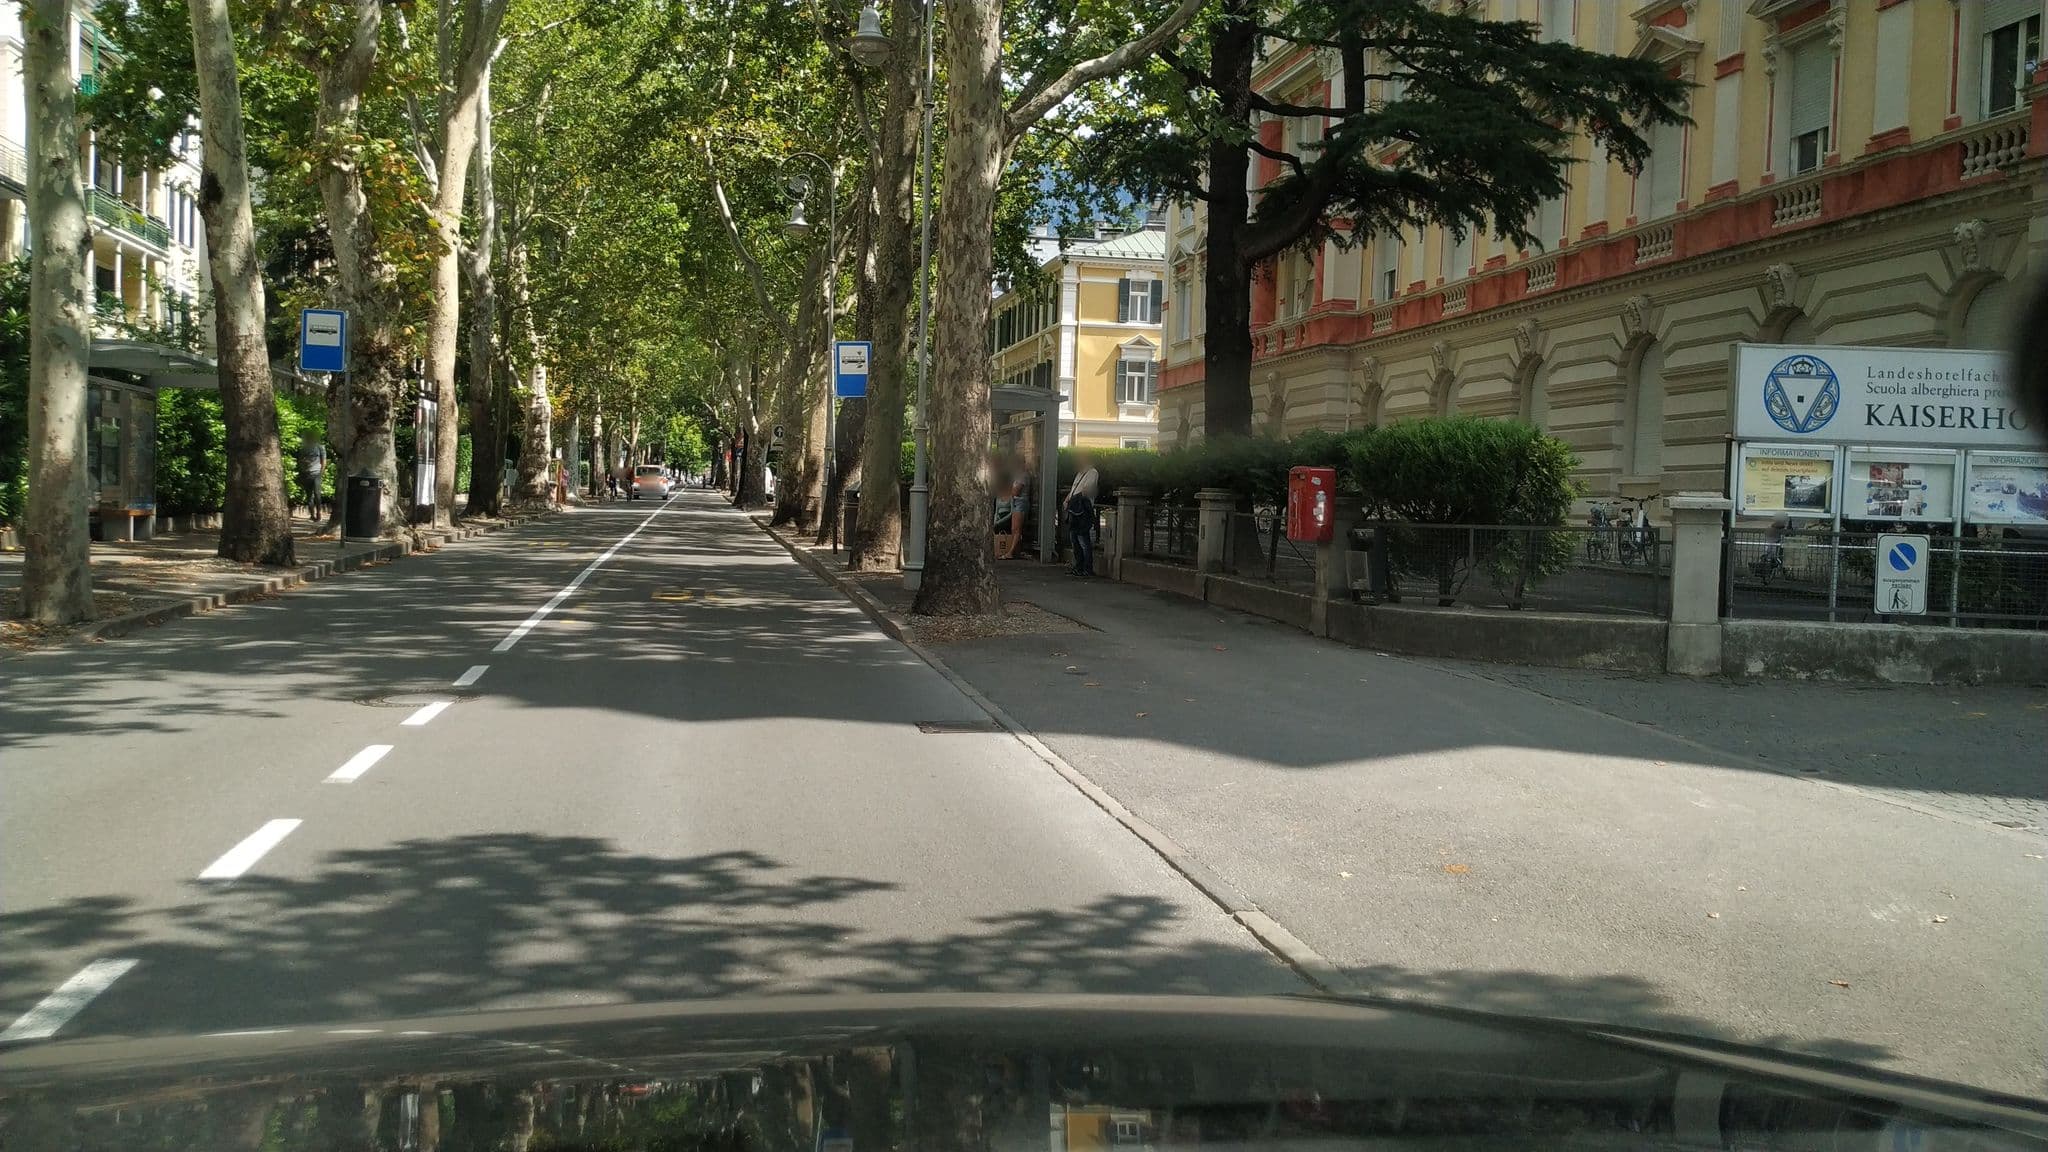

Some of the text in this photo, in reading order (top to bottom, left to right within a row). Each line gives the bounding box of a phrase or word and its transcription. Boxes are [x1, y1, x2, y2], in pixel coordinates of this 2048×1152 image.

[1866, 382, 1907, 395] Scuola
[1911, 382, 1980, 398] alberghiera
[1759, 448, 1821, 458] INFORMATIONEN
